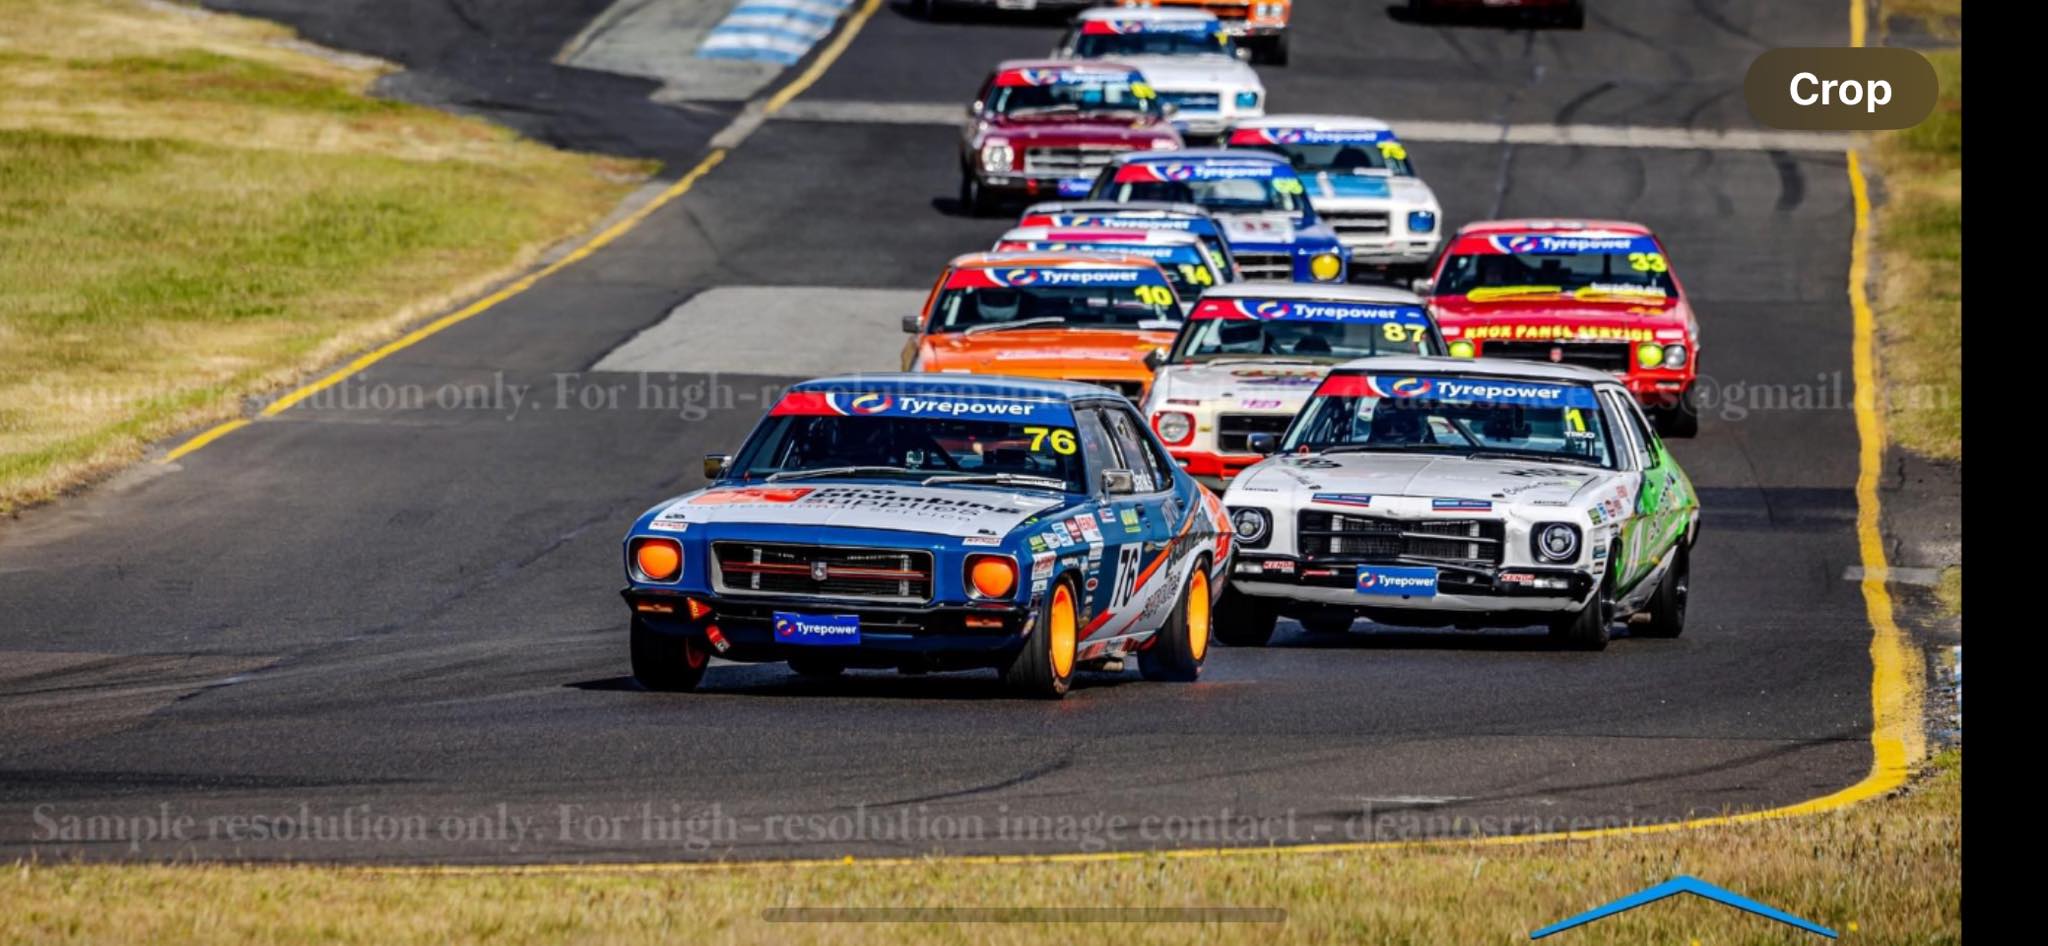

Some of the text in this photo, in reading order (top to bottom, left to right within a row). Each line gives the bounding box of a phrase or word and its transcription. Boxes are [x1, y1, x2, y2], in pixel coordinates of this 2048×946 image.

[1541, 238, 1632, 250] Tyrepower
[1628, 252, 1668, 272] 33
[1041, 269, 1138, 284] Tyrepower
[1177, 264, 1213, 287] 14
[1135, 285, 1173, 306] 10
[1293, 303, 1397, 320] Tyrepower
[1382, 322, 1427, 343] 87
[1464, 325, 1513, 339] KNOX
[1516, 324, 1574, 339] PANEL
[1436, 380, 1561, 399] Tyrepower
[899, 396, 1035, 416] Tyrepower
[1564, 408, 1586, 432] 1
[1023, 427, 1078, 456] 76
[1113, 548, 1139, 608] 76
[1377, 574, 1435, 588] Tyrepower
[796, 621, 857, 635] Tyrepower
